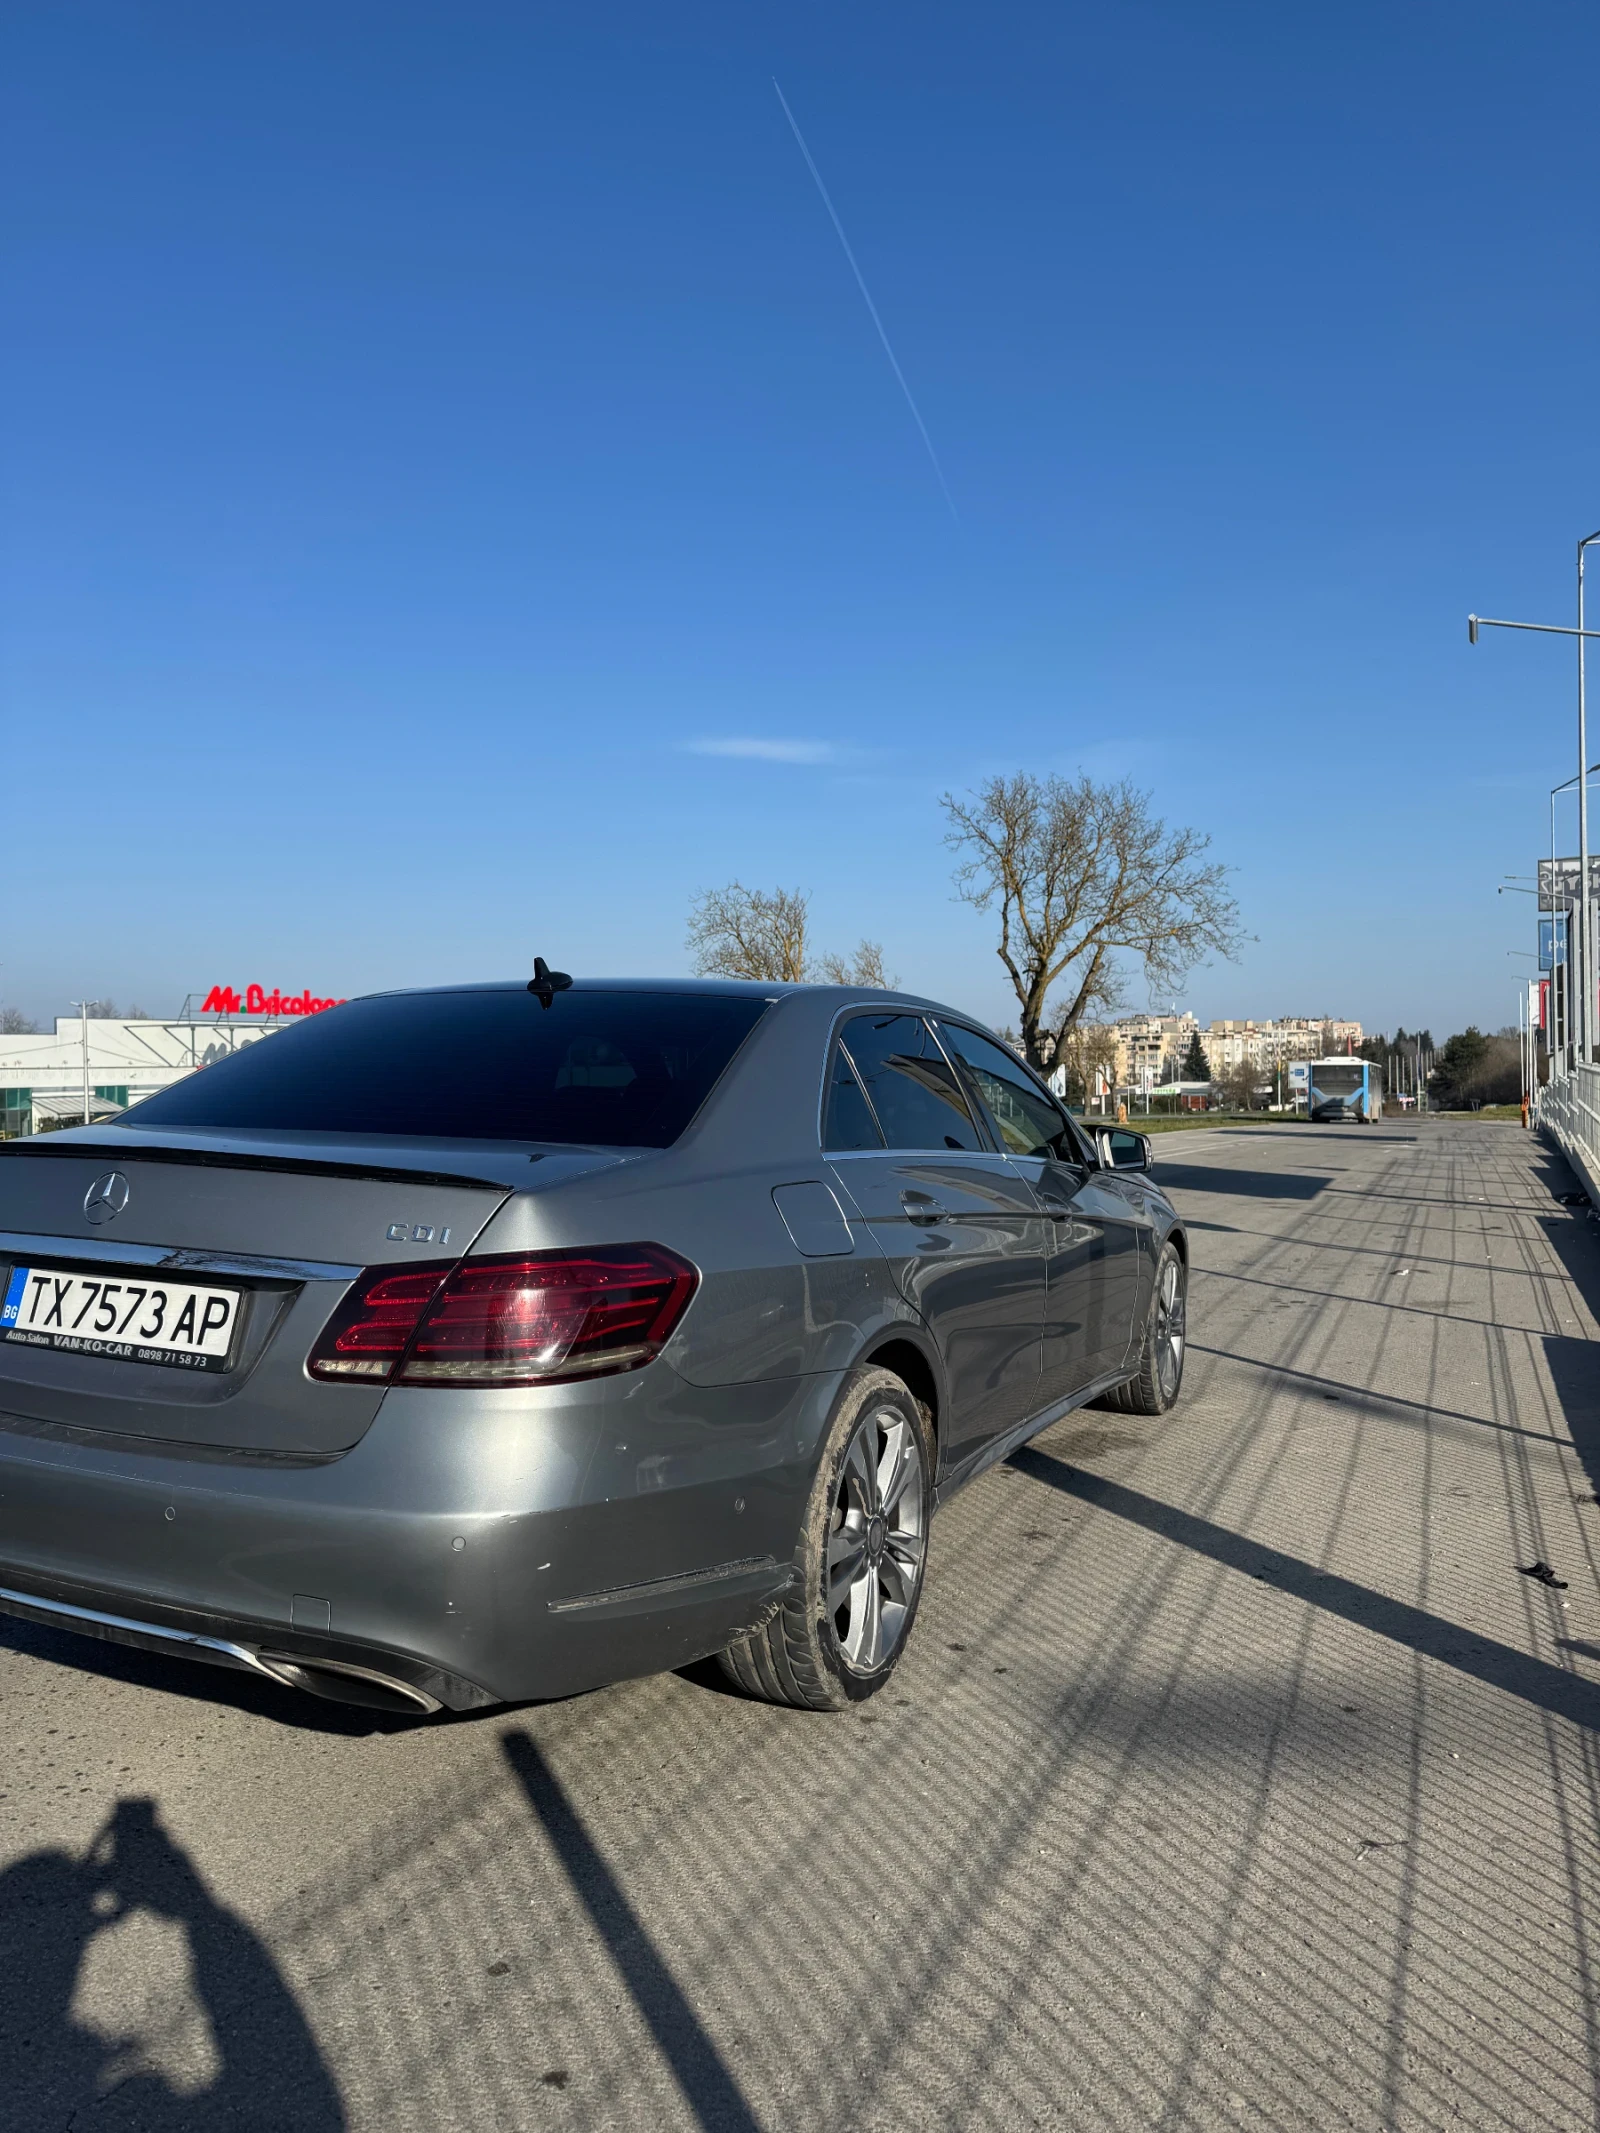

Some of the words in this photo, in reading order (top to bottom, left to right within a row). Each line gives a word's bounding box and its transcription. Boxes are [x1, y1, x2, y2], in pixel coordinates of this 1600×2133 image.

[386, 1223, 451, 1244] CDI
[4, 1304, 18, 1319] BG
[71, 1281, 168, 1339] 7573
[6, 1330, 26, 1342] Auto
[27, 1333, 50, 1345] Salon
[53, 1335, 133, 1356] VAN-KO-CAR
[138, 1348, 162, 1361] 0898
[164, 1353, 176, 1363] 71
[178, 1355, 191, 1364] 58
[194, 1356, 207, 1367] 73
